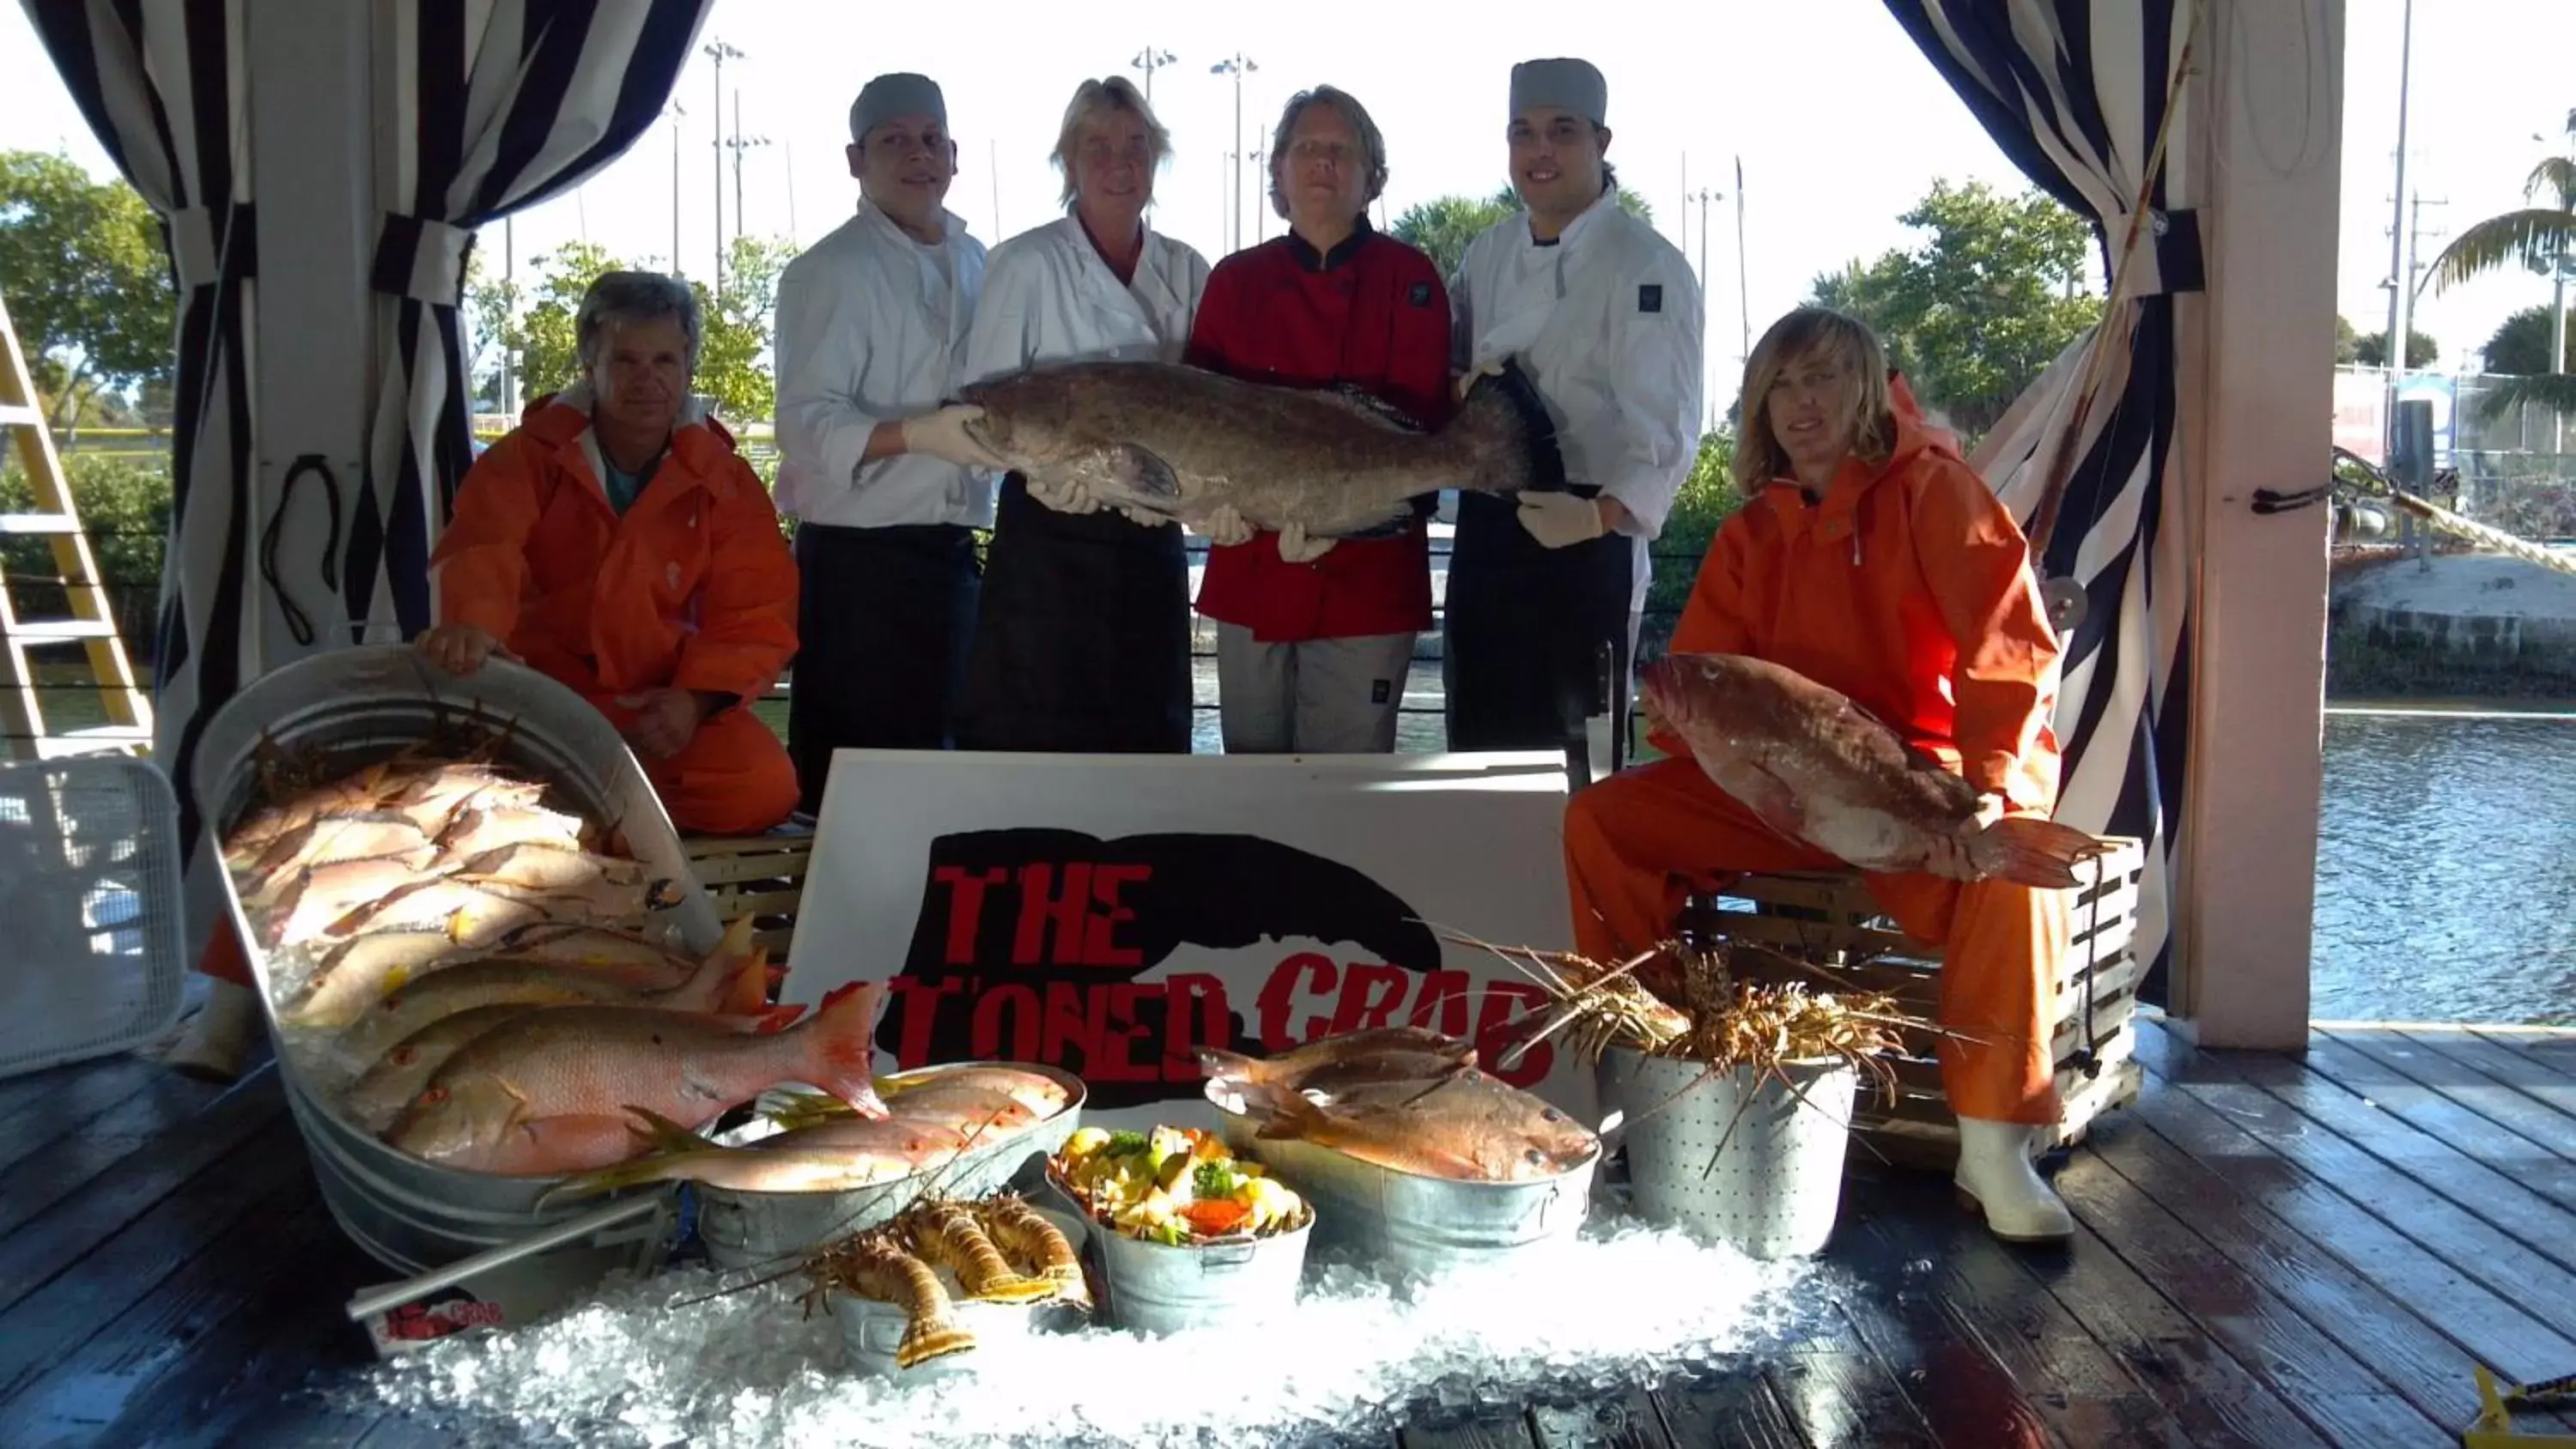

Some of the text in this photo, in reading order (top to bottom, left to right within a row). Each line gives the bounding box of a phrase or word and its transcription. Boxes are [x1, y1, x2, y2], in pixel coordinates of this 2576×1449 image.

[933, 862, 1152, 965] THE
[821, 951, 1553, 1089] TONED CRAB
